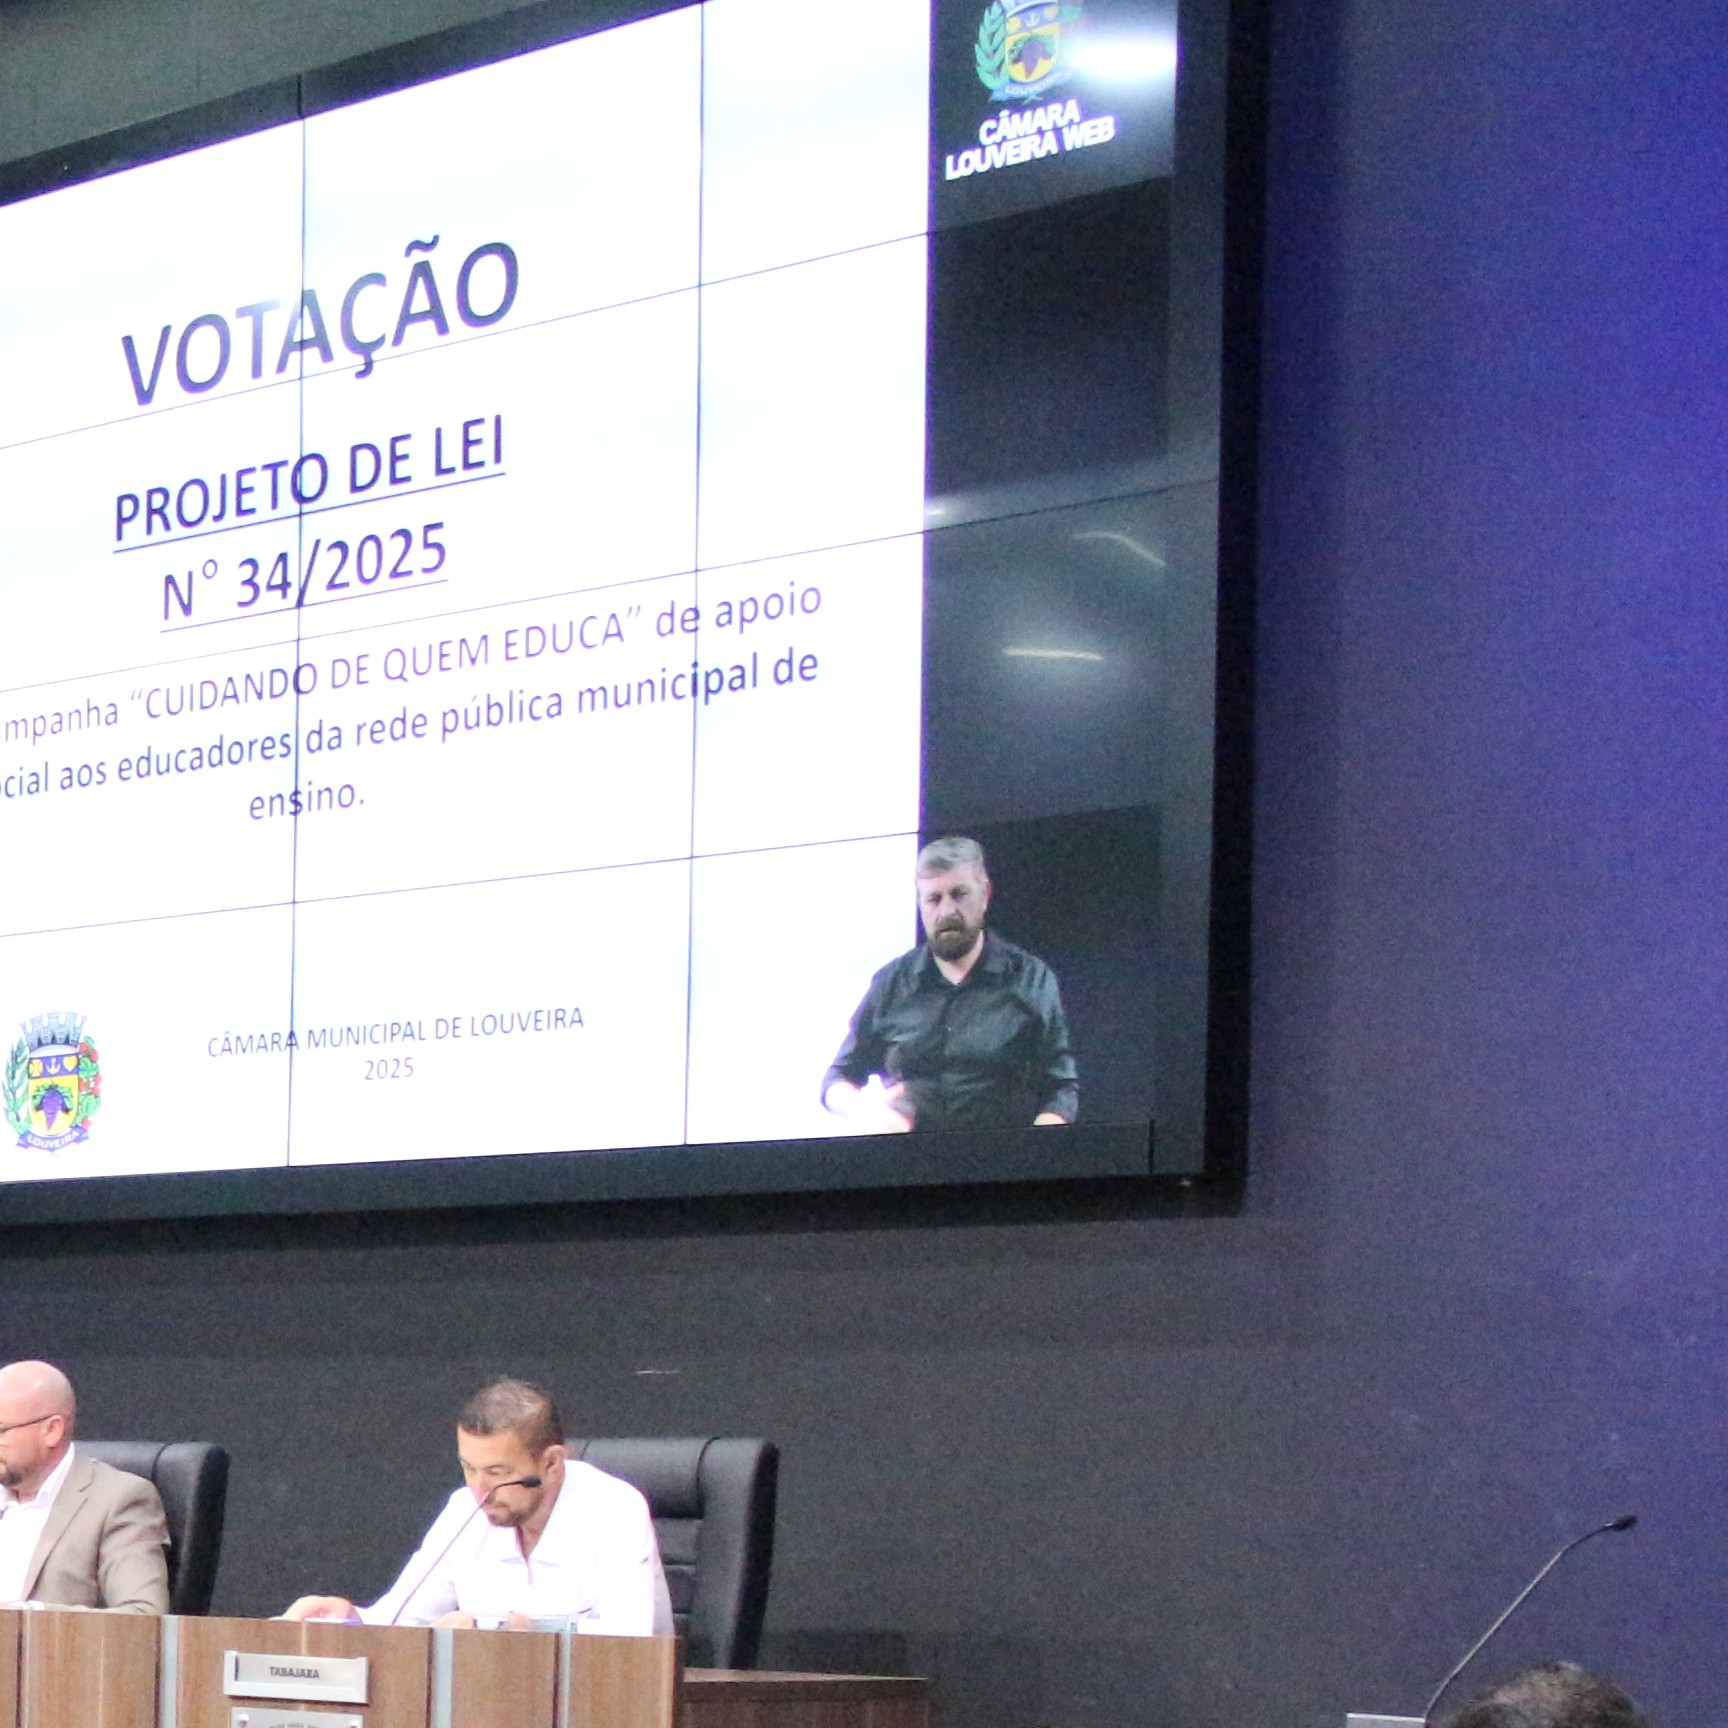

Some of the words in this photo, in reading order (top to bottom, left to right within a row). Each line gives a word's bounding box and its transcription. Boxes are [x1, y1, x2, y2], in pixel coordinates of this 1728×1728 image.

[945, 128, 1058, 181] LOUVEIRA
[1062, 115, 1117, 151] WEB
[978, 99, 1081, 146] CÂMARA
[120, 235, 521, 407] VOTAÇÃO
[114, 450, 330, 542] PROJETO
[347, 433, 413, 495] DE
[433, 413, 506, 478] LEI
[236, 520, 448, 606] 34/2025
[329, 650, 371, 693] DE
[382, 633, 490, 682] QUEM
[655, 599, 701, 638] de
[714, 580, 823, 634] apoio
[58, 758, 108, 792] aos
[116, 730, 292, 783] educadores
[305, 716, 343, 755] da
[355, 706, 430, 747] rede
[440, 688, 564, 744] pública
[577, 650, 759, 714] municipal
[772, 645, 819, 686] de
[247, 780, 367, 822] ensino.
[206, 1029, 300, 1059] CÂMARA
[307, 1019, 428, 1050] MUNICIPAL
[434, 1015, 463, 1040] DE
[470, 1006, 585, 1038] LOUVEIRA
[363, 1055, 415, 1082] 2025
